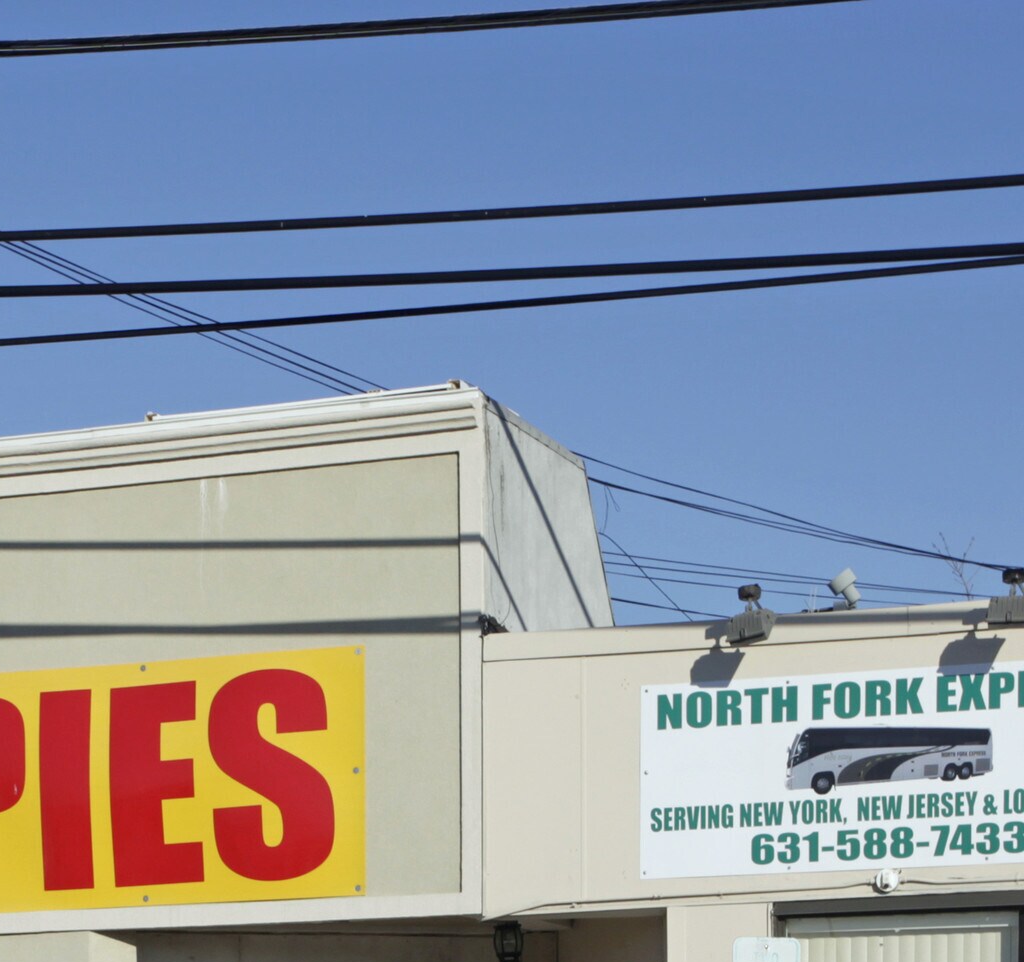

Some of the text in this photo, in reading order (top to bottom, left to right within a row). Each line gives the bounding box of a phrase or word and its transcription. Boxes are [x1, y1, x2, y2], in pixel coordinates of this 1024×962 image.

[657, 686, 798, 730] NORTH
[811, 677, 924, 720] FORK
[650, 804, 734, 832] SERVING
[739, 801, 784, 827] NEW
[789, 798, 847, 825] YORK,
[857, 794, 902, 821] NEW
[907, 791, 978, 819] JERSEY
[982, 794, 997, 815] &
[750, 821, 1024, 865] 631-588-7433
